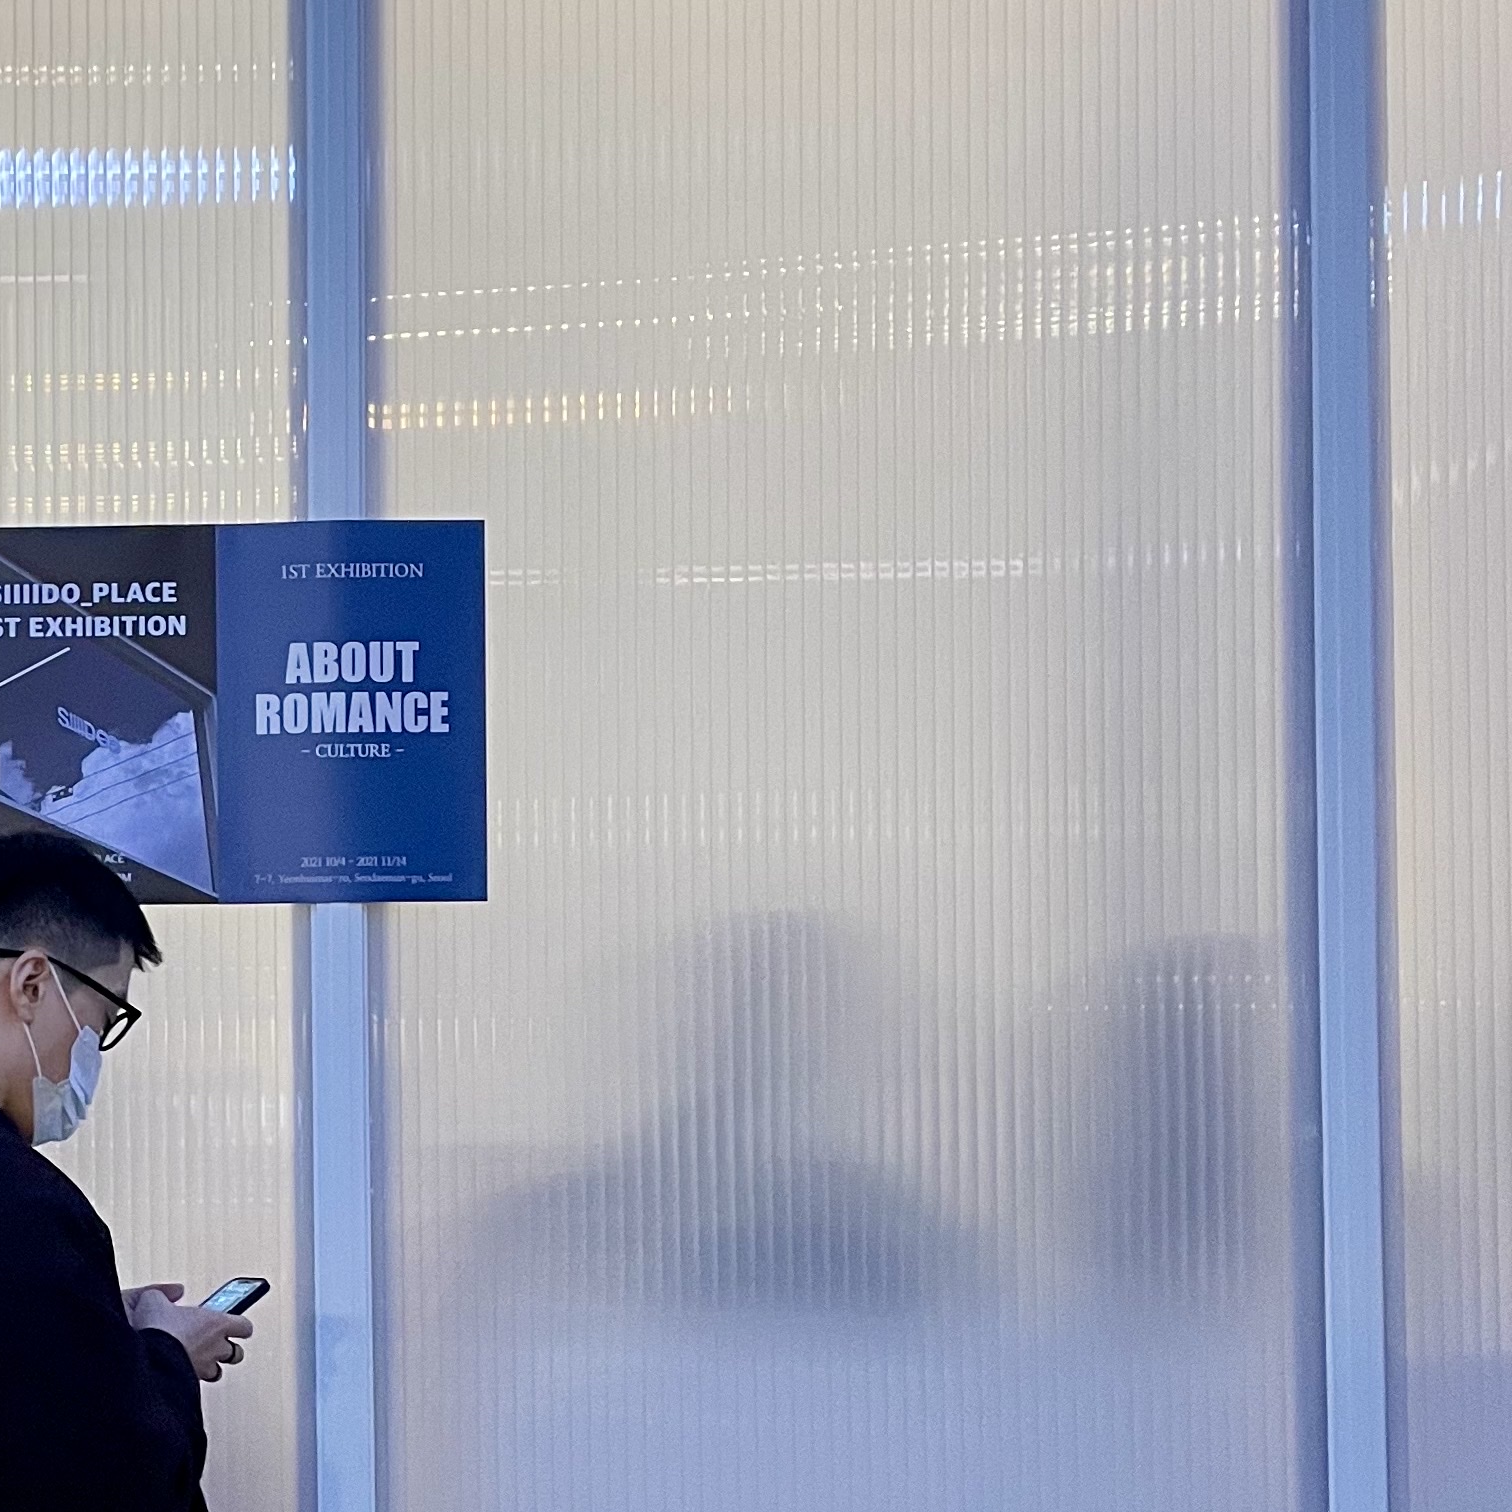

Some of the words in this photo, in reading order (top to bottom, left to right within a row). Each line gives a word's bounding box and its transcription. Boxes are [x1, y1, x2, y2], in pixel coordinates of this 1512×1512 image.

[279, 563, 309, 578] 1ST
[315, 562, 424, 579] EXHIBITION
[29, 615, 186, 637] EXHIBITION
[285, 642, 420, 684] ABOUT
[255, 691, 450, 735] ROMANCE
[314, 742, 391, 760] CULTURE
[301, 857, 322, 868] 2021
